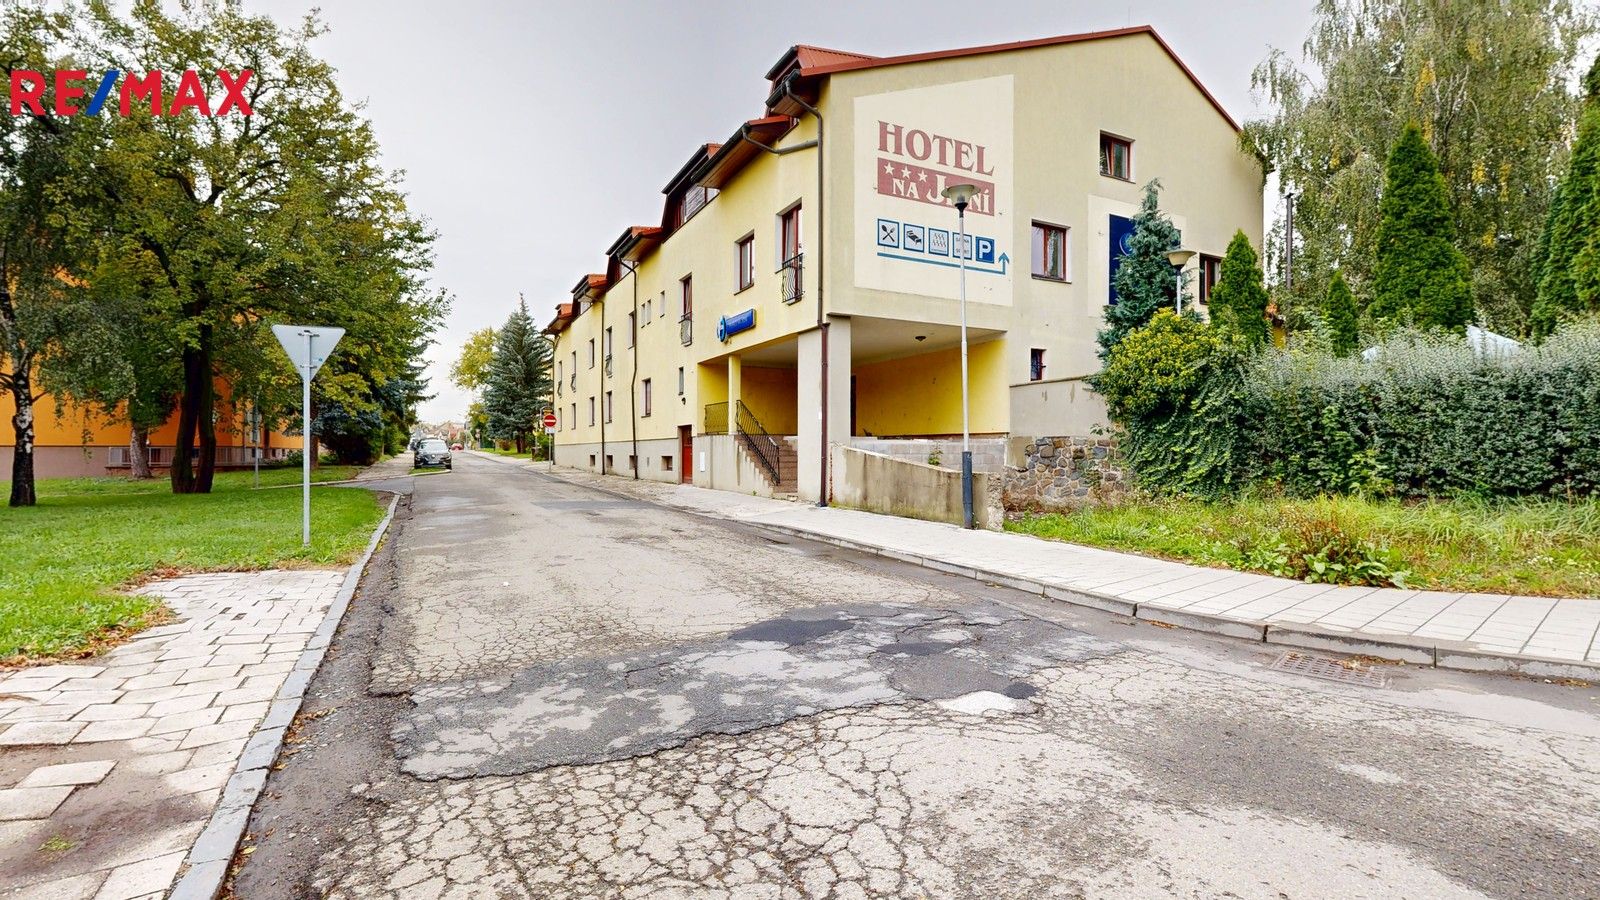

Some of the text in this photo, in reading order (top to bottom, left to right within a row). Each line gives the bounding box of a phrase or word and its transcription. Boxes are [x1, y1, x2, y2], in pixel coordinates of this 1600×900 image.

[878, 120, 995, 176] HOTEL
[892, 174, 990, 213] NA JNÍ
[978, 240, 992, 259] P
